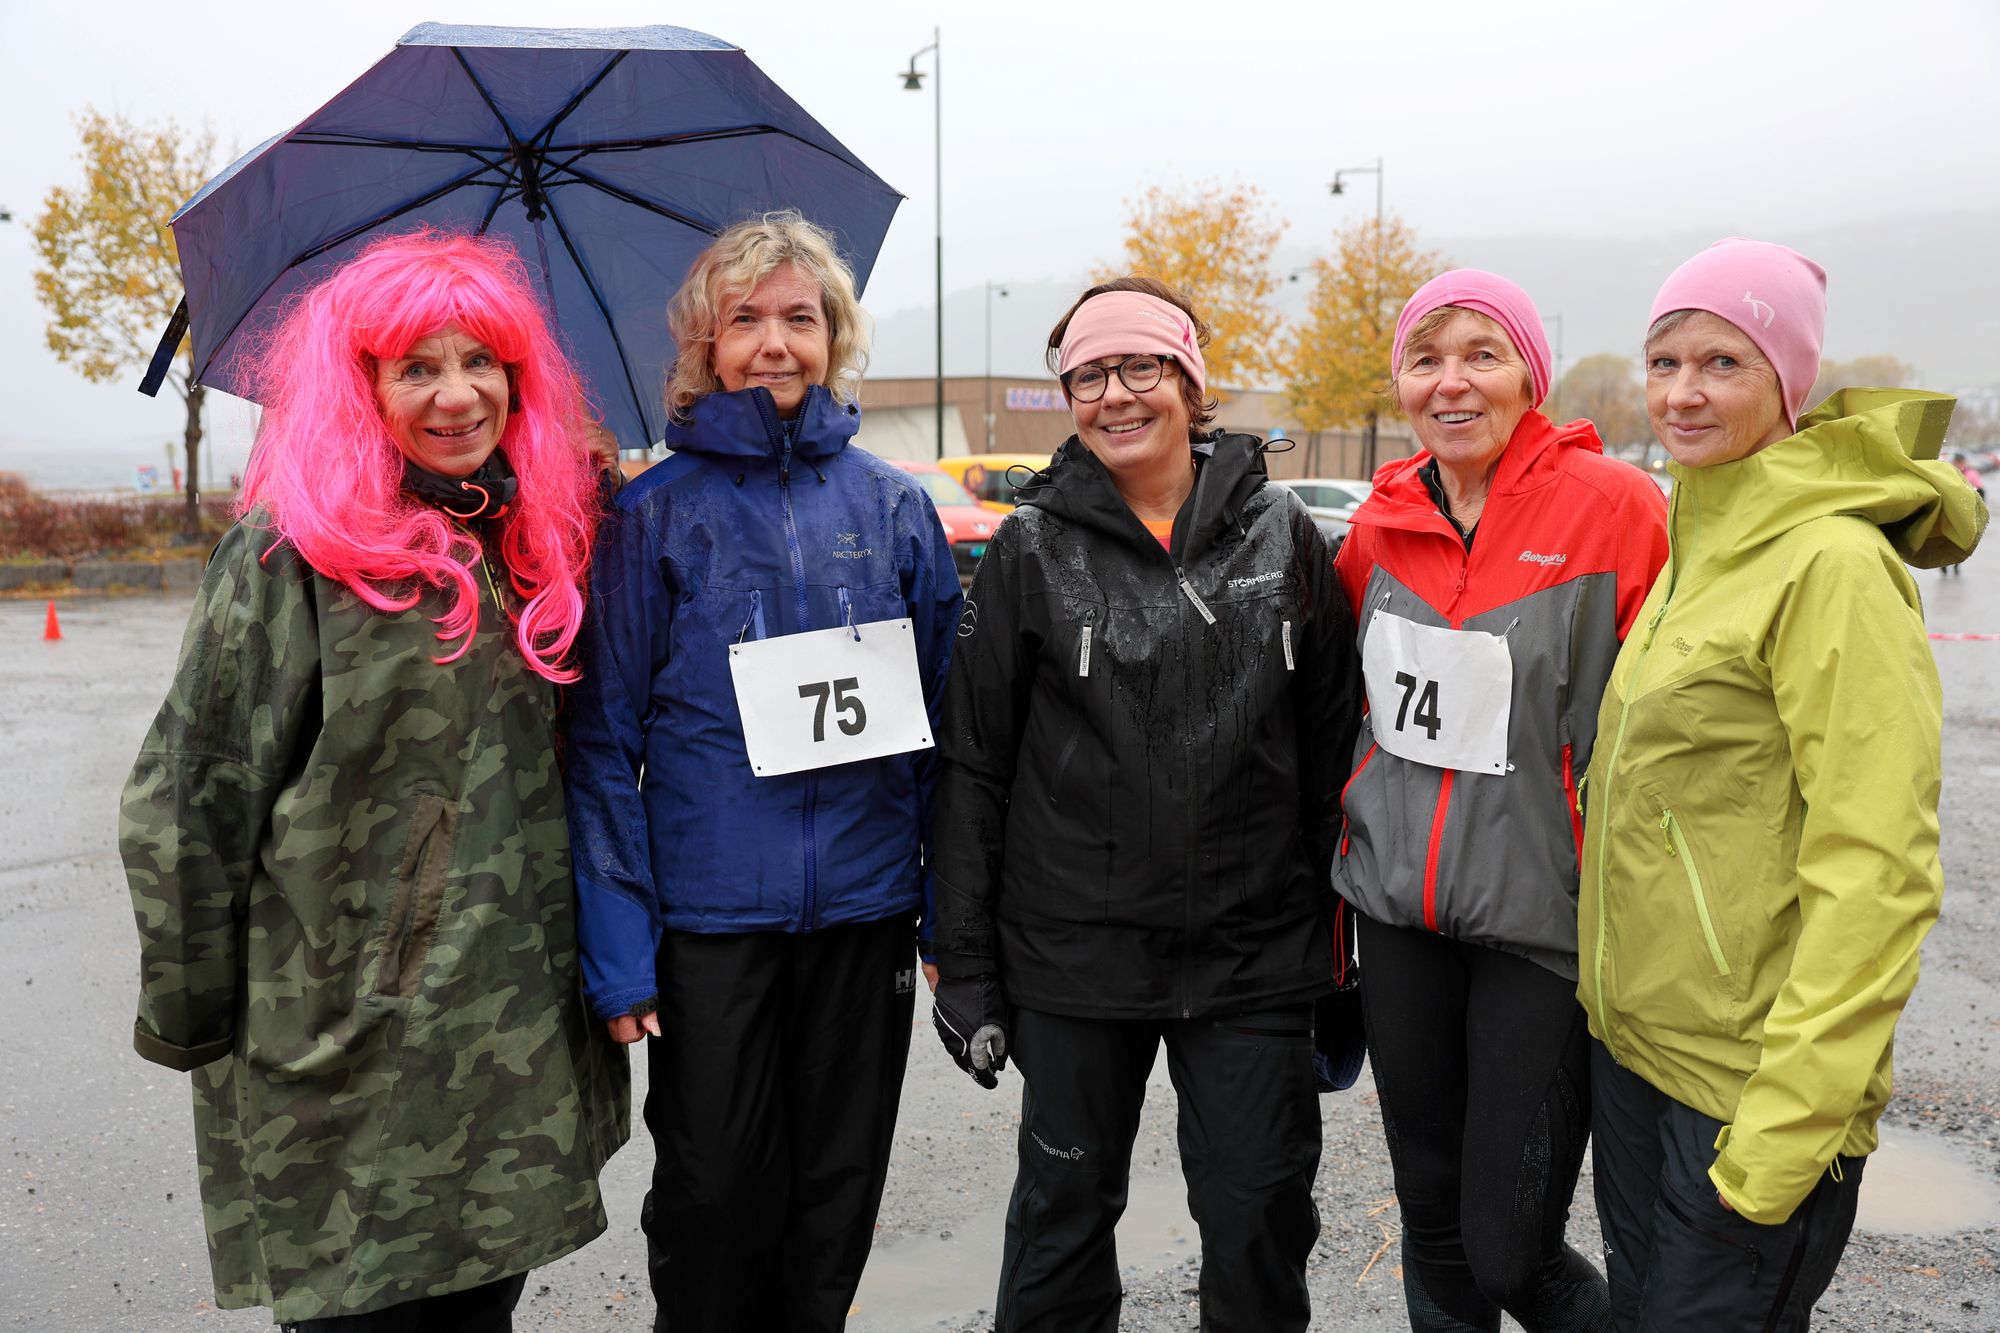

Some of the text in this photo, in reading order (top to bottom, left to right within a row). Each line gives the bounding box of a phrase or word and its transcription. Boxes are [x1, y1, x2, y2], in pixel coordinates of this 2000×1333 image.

[1227, 570, 1284, 588] STORMBERG
[798, 676, 867, 743] 75
[1395, 671, 1442, 741] 74
